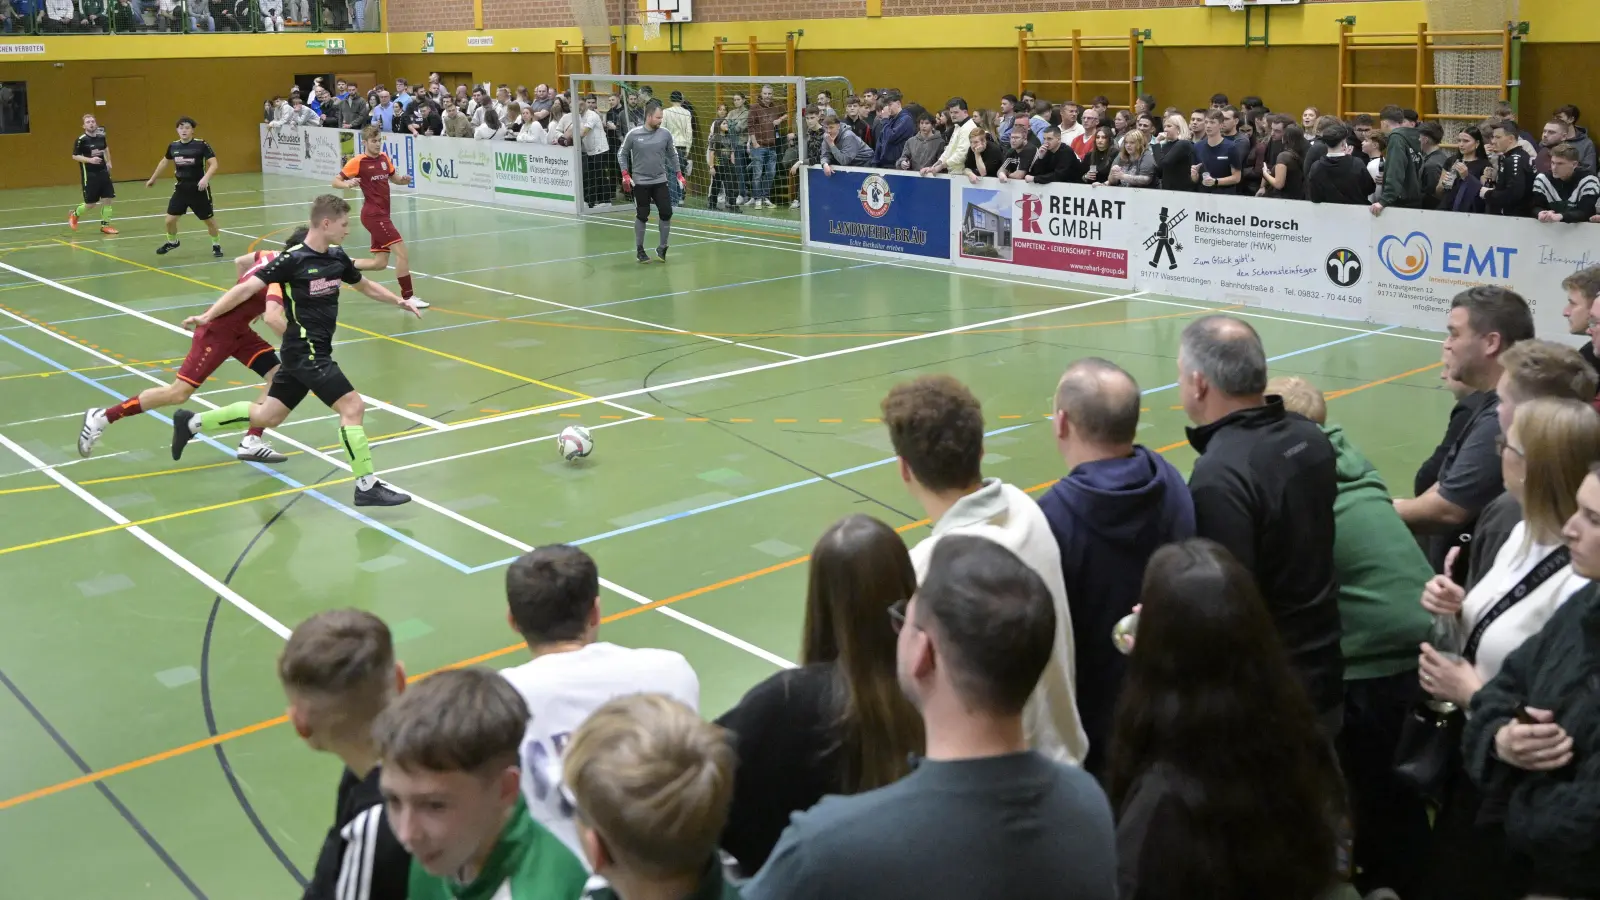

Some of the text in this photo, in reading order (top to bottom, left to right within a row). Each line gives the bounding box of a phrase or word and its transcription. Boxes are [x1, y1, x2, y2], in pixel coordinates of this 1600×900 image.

[436, 158, 459, 179] S&L
[529, 154, 544, 164] Erwin
[1049, 195, 1126, 220] REHART
[1048, 217, 1102, 241] GMBH
[1194, 210, 1299, 231] Michael Dorsch
[829, 220, 928, 245] LANDWEHR-BRÄU
[1194, 224, 1313, 244] Bezirksschornsteinfegermeister
[1014, 241, 1125, 260] KOMPETENZ LEIDENSCHAFT EFFIZIENZ
[1194, 236, 1277, 253] Energieberater (HWK)
[1069, 263, 1125, 275] www.rehart-group.de
[1193, 256, 1210, 266] Zum
[1211, 254, 1233, 265] Glück
[1442, 241, 1518, 279] EMT
[1236, 266, 1318, 280] den Schornsteinfeger
[1140, 270, 1363, 304] 91717 Wassertrüdingen Bahnhofstraße 8 Tel. 09832 70 44 506
[1377, 281, 1434, 294] Am Krautgarten 12
[1377, 290, 1397, 299] 91717
[1398, 291, 1450, 306] Wassertrüdingen
[1412, 303, 1453, 315] info@emt-p
